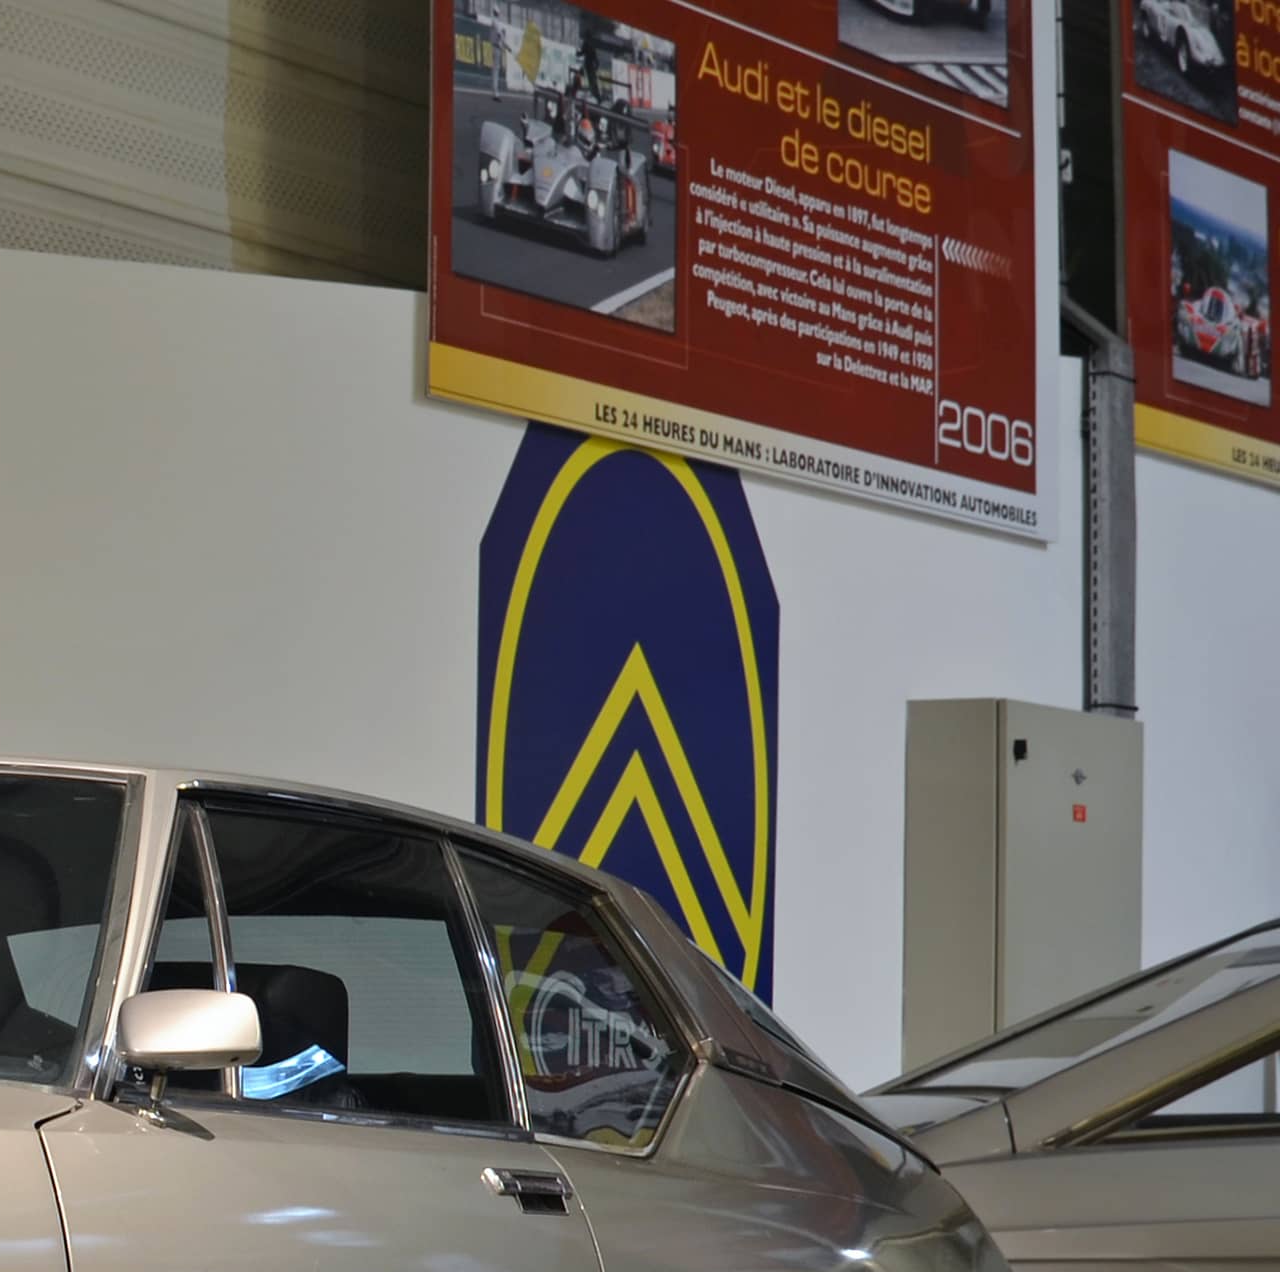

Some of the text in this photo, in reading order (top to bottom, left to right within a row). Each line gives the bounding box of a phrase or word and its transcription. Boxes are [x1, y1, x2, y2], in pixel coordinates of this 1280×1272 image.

[698, 41, 931, 164] Audi et le diesel
[710, 157, 724, 178] Le
[725, 167, 763, 190] moteur
[765, 176, 798, 205] Diesel,
[798, 192, 832, 215] apparu
[833, 204, 845, 219] en
[886, 218, 933, 251] longtemps
[781, 128, 931, 214] de course
[689, 182, 738, 209] considéré
[802, 215, 814, 234] Sa
[816, 223, 860, 249] puissance
[862, 239, 907, 265] augmente
[696, 205, 703, 224] à
[754, 225, 761, 244] à
[762, 227, 791, 253] haute
[792, 242, 832, 265] pression
[833, 255, 844, 269] et
[845, 254, 851, 272] à
[853, 257, 861, 275] la
[698, 238, 717, 256] par
[809, 269, 832, 291] Cela
[846, 285, 873, 304] ouvre
[874, 288, 883, 308] la
[884, 296, 910, 316] porte
[911, 302, 923, 320] de
[923, 305, 933, 323] la
[757, 282, 779, 301] avec
[780, 287, 817, 313] victoire
[818, 301, 831, 317] au
[831, 301, 857, 324] Mans
[891, 320, 913, 341] Audi
[914, 330, 933, 348] puis
[751, 307, 779, 326] après
[779, 312, 797, 332] des
[798, 321, 862, 352] participations
[863, 340, 876, 354] en
[900, 350, 910, 365] et
[816, 351, 832, 368] sur
[833, 352, 842, 371] la
[889, 372, 899, 387] et
[900, 371, 910, 390] la
[595, 403, 617, 425] LES
[622, 409, 638, 430] 24
[642, 414, 695, 444] HEURES
[700, 429, 719, 449] DU
[723, 435, 762, 460] MANS
[773, 447, 861, 485] LABORATOIRE
[864, 470, 957, 507] D'INNOVATIONS
[960, 495, 1038, 527] AUTOMOBILES
[938, 399, 1034, 467] 2006
